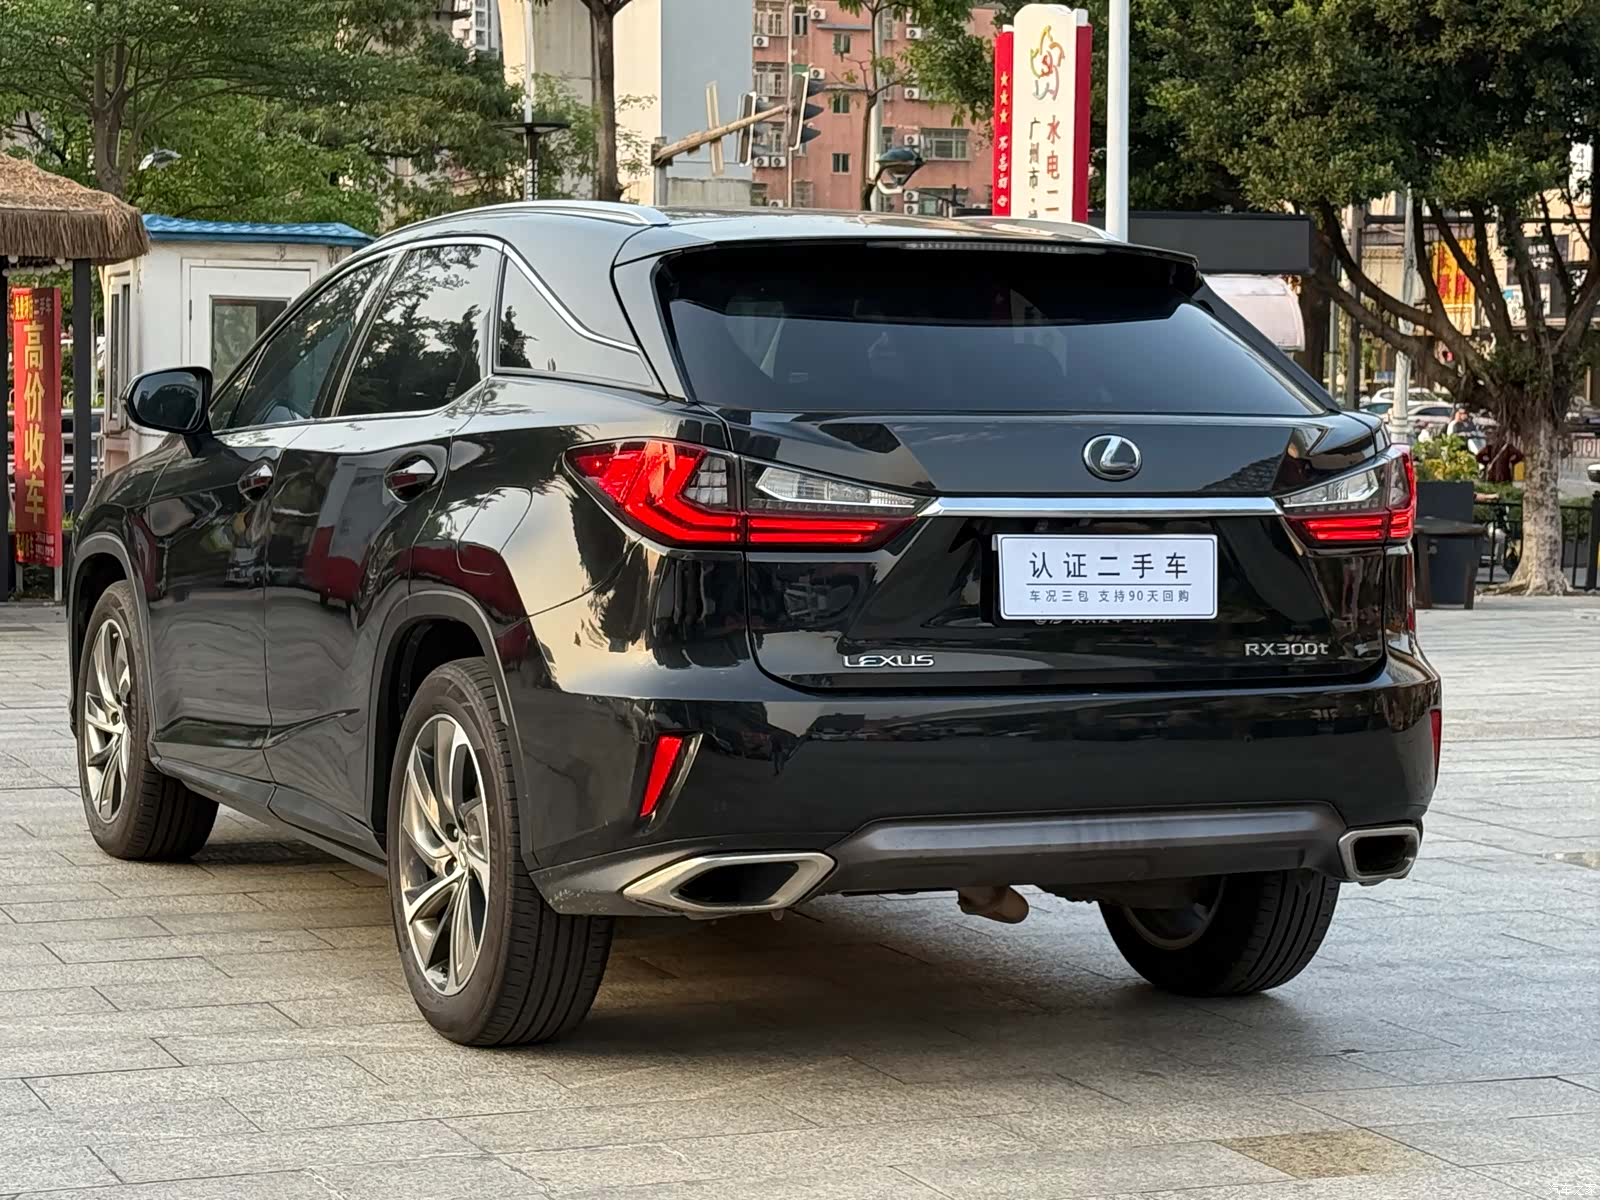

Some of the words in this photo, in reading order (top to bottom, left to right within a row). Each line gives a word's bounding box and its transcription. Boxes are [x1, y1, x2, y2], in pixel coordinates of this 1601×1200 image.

[23, 320, 46, 525] 高价收车
[1029, 551, 1189, 580] 认证二手车
[1029, 589, 1090, 603] 车况三包
[1098, 589, 1190, 603] 支持90天回购
[1244, 642, 1330, 657] RX300t
[843, 654, 935, 668] LEXUS
